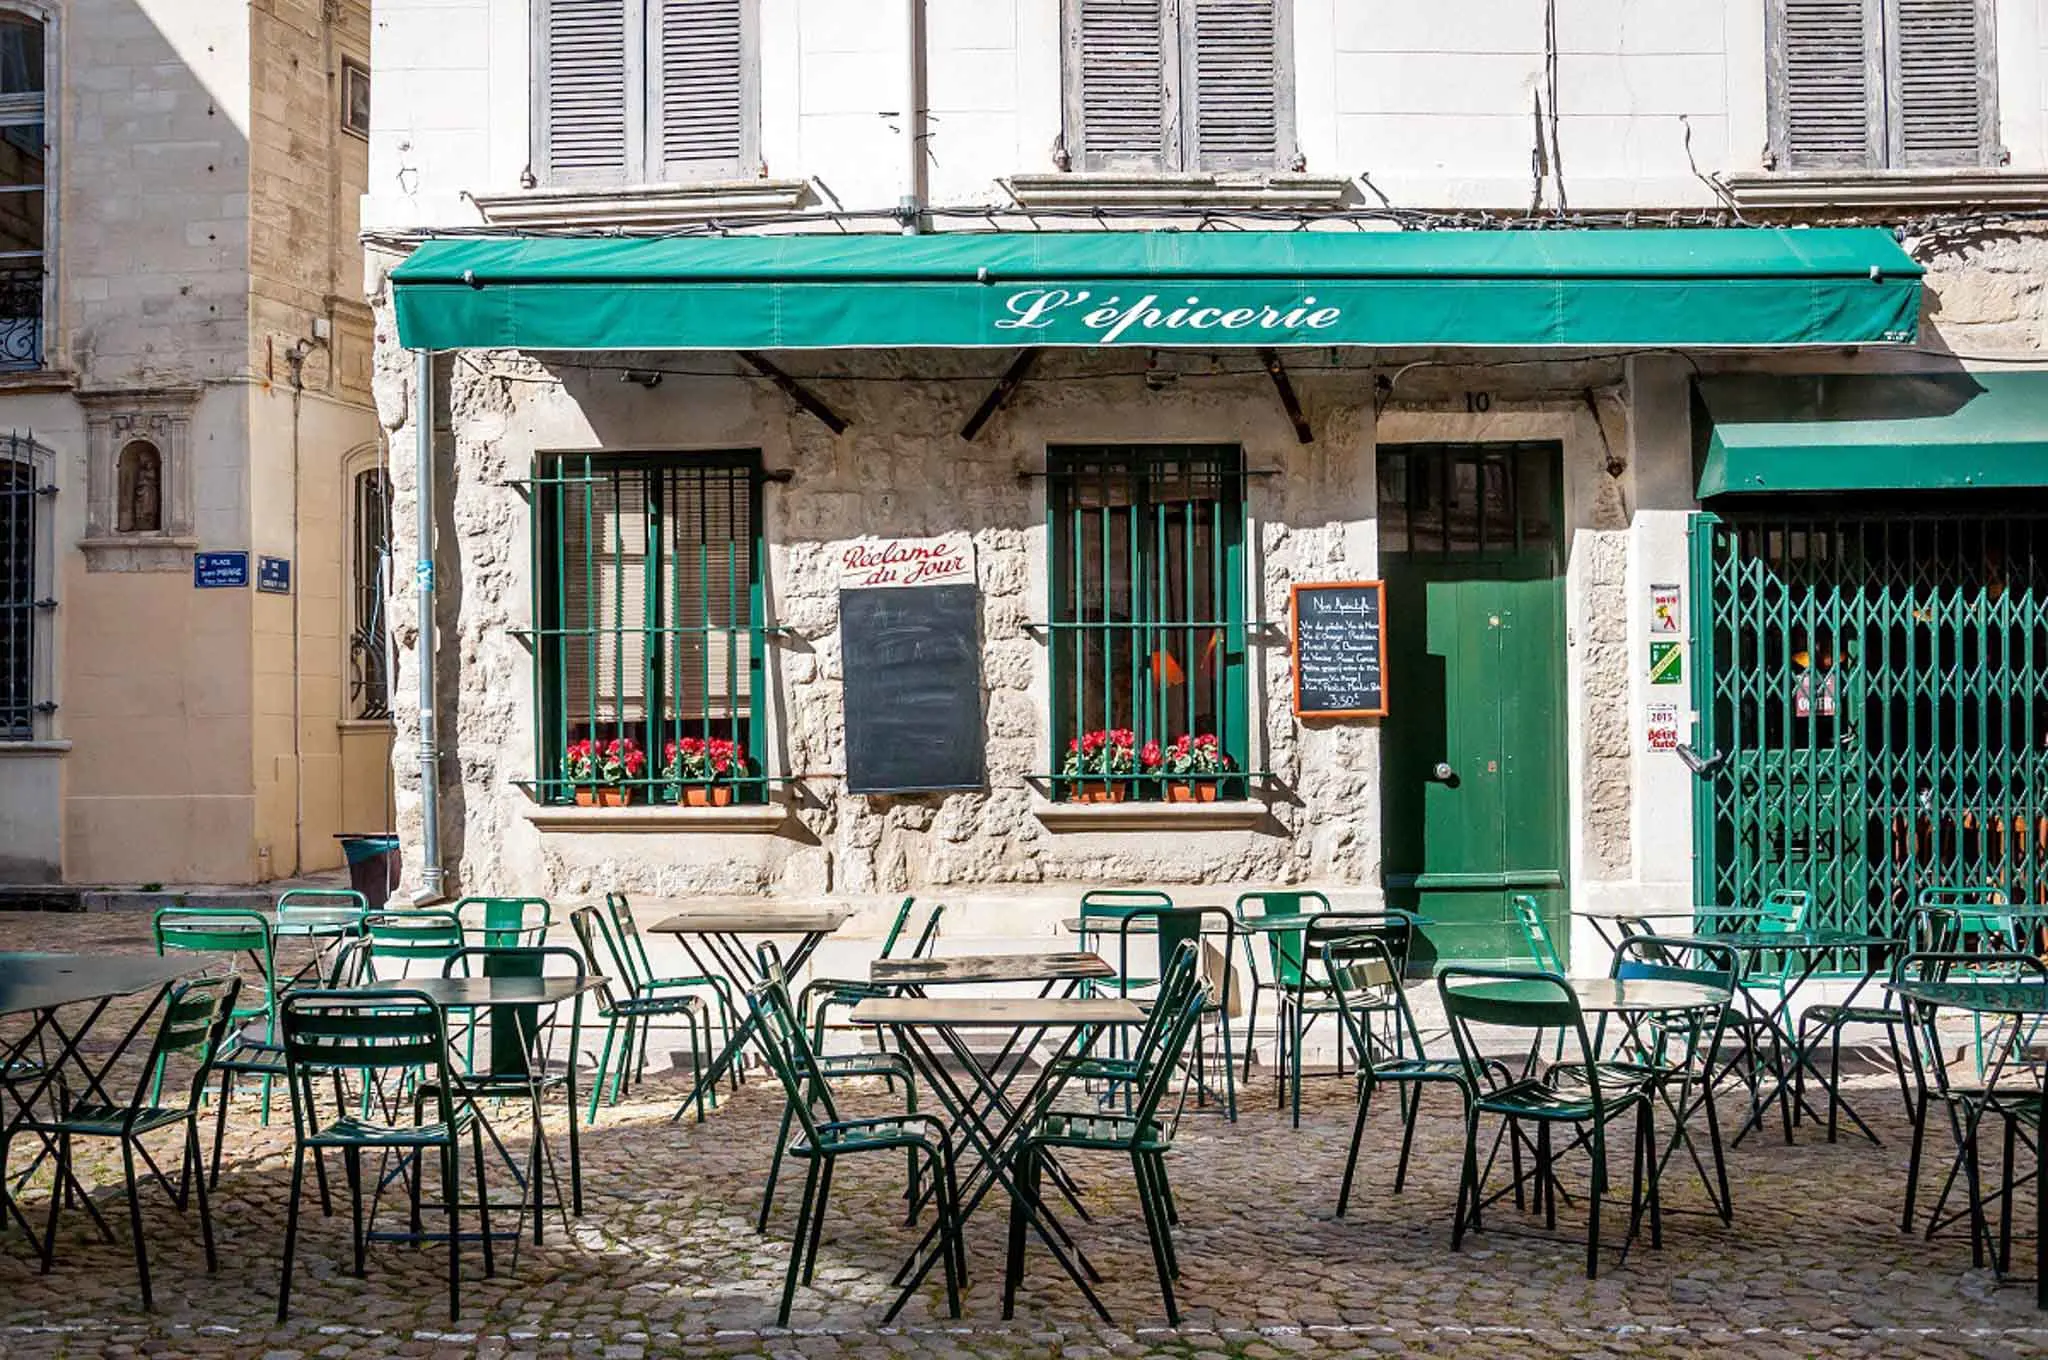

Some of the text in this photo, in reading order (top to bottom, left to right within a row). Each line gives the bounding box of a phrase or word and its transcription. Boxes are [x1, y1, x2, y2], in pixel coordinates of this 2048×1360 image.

[994, 289, 1342, 343] L'épicerie
[1466, 391, 1490, 412] 10
[843, 541, 956, 569] Réclame
[862, 556, 965, 585] du Jour
